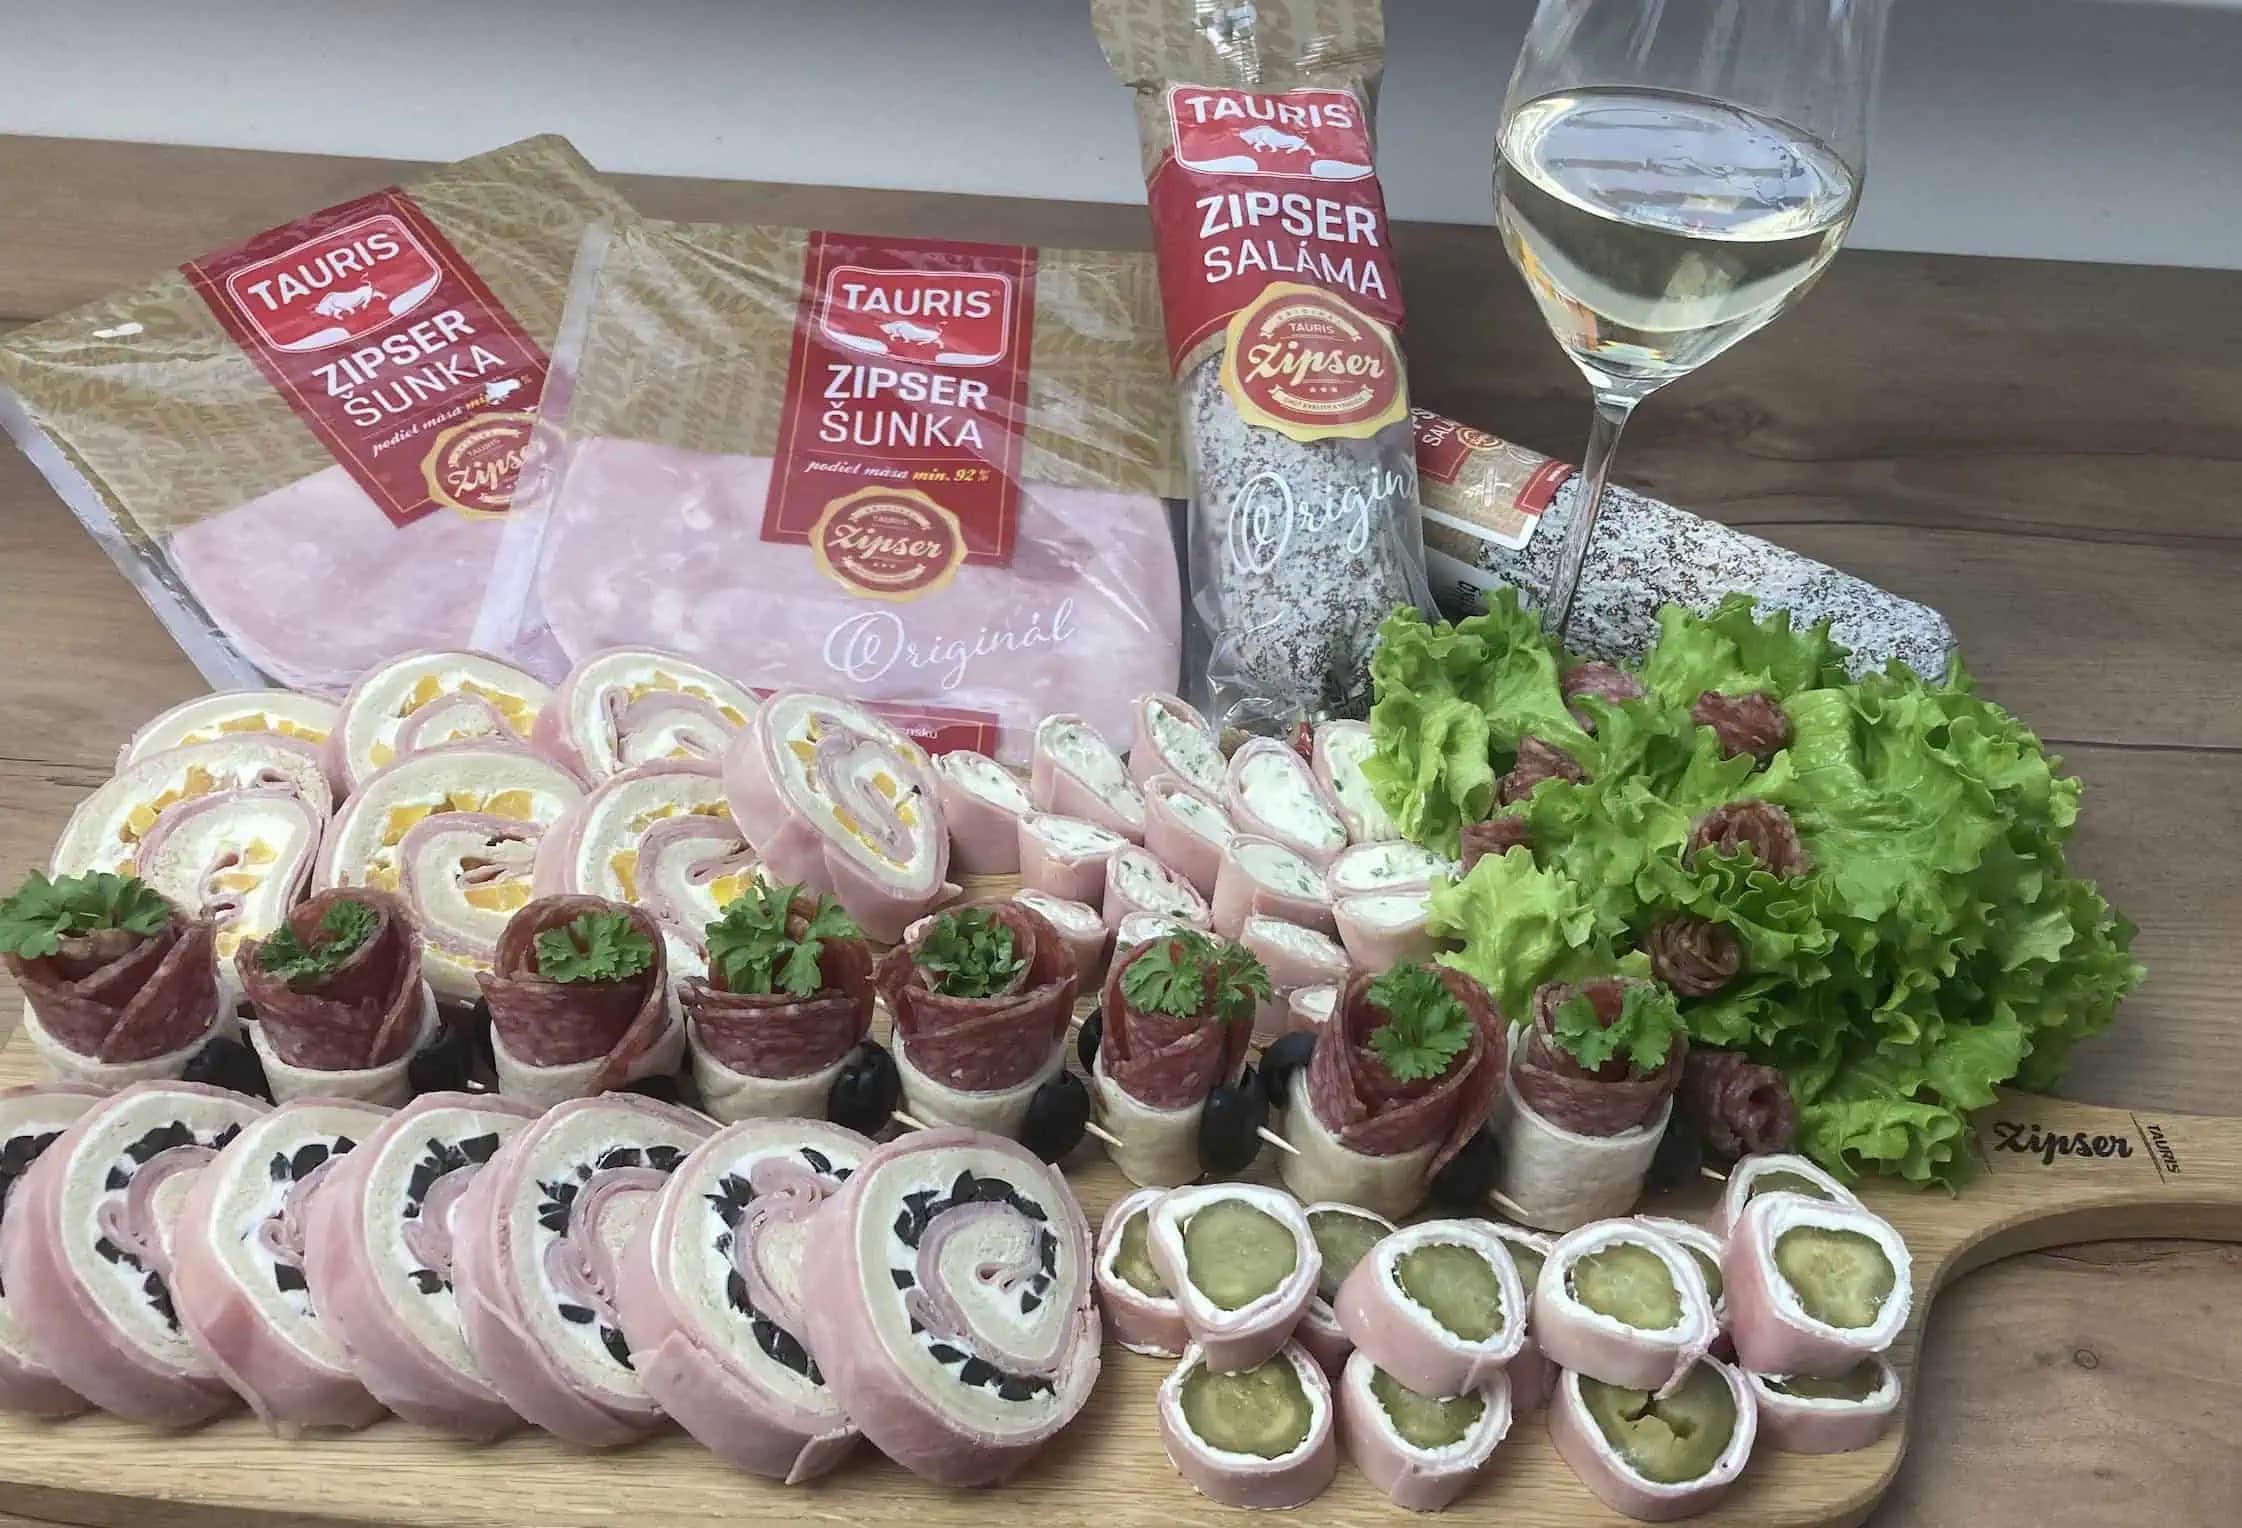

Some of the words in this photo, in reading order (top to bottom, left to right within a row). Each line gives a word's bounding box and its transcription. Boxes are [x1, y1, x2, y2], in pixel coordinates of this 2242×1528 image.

[1185, 95, 1353, 129] TAURIS
[1196, 191, 1379, 247] ZIPSER
[247, 233, 401, 311] TAURIS
[1203, 239, 1387, 299] SALÁMA
[841, 283, 992, 319] TAURIS
[1288, 322, 1336, 335] TAURIS
[311, 309, 475, 398] ZIPSER
[1245, 341, 1384, 387] Zipser
[340, 344, 506, 427] ŠUNKA
[823, 363, 989, 411] ZIPSER
[819, 400, 984, 450] ŠUNKA
[912, 468, 950, 481] min.
[826, 524, 943, 560] Zipser
[823, 598, 1081, 690] Originál
[1992, 1120, 2133, 1166] Zipser
[2147, 1124, 2181, 1174] TAURIS
